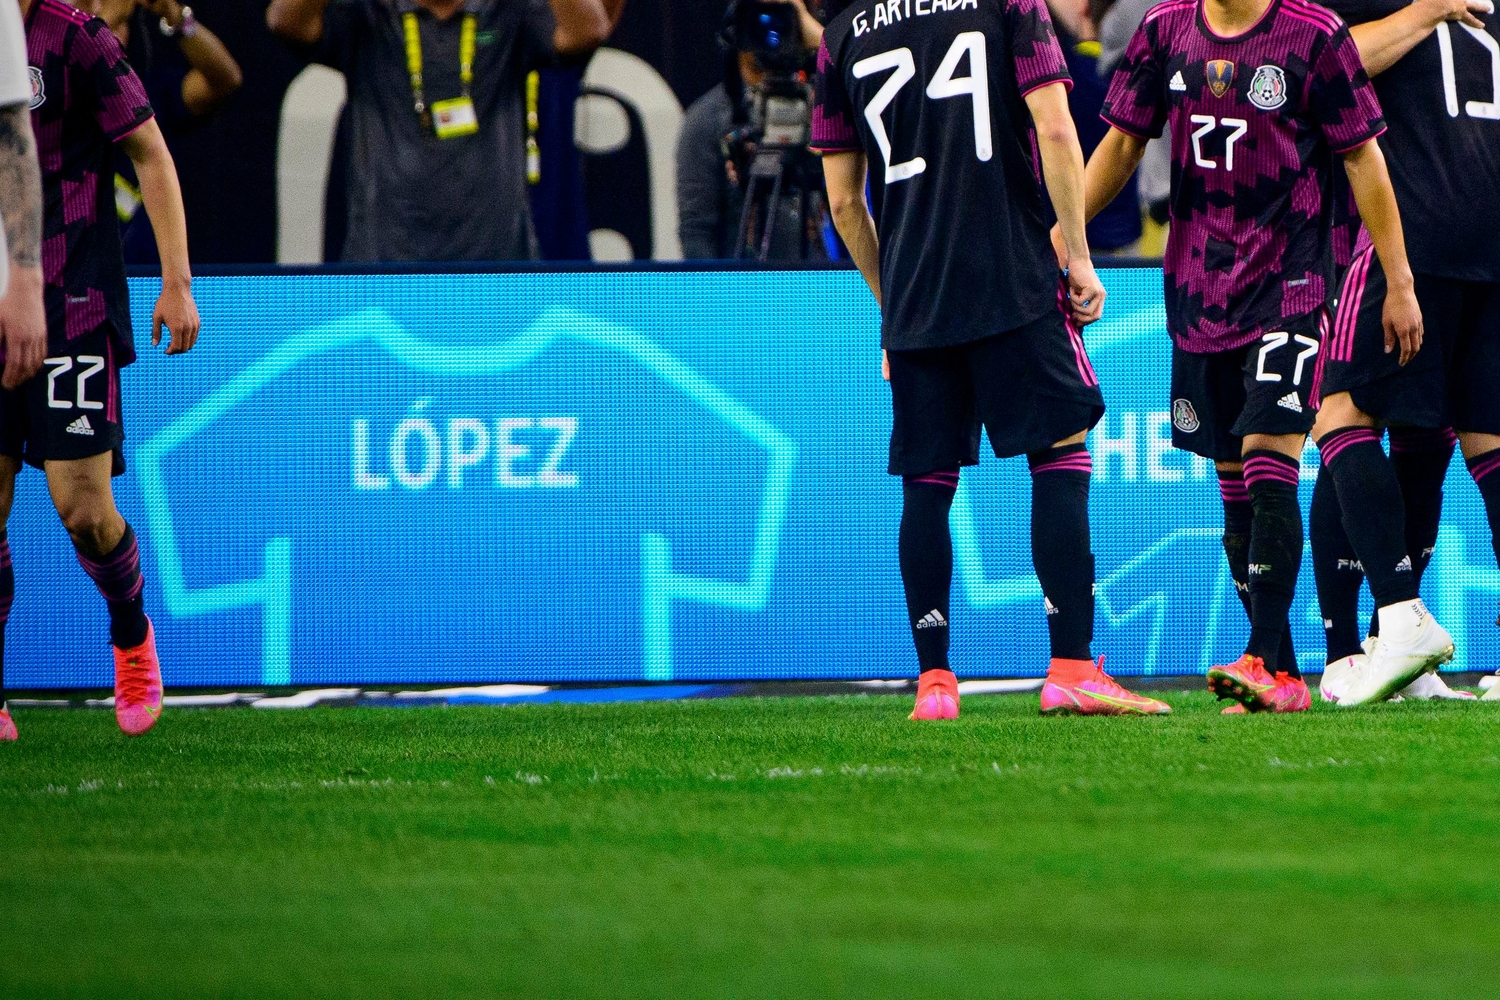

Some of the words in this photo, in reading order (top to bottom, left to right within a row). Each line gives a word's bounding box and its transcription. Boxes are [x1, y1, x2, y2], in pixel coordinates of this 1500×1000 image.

[852, 10, 871, 37] G.
[852, 30, 993, 185] 24
[1190, 114, 1248, 172] 27
[1255, 331, 1320, 386] 27
[43, 355, 105, 410] 22
[1277, 399, 1303, 413] adidas
[65, 425, 95, 436] adidas
[353, 396, 580, 490] LÓPEZ
[1337, 558, 1366, 572] FM
[916, 619, 948, 630] adidas
